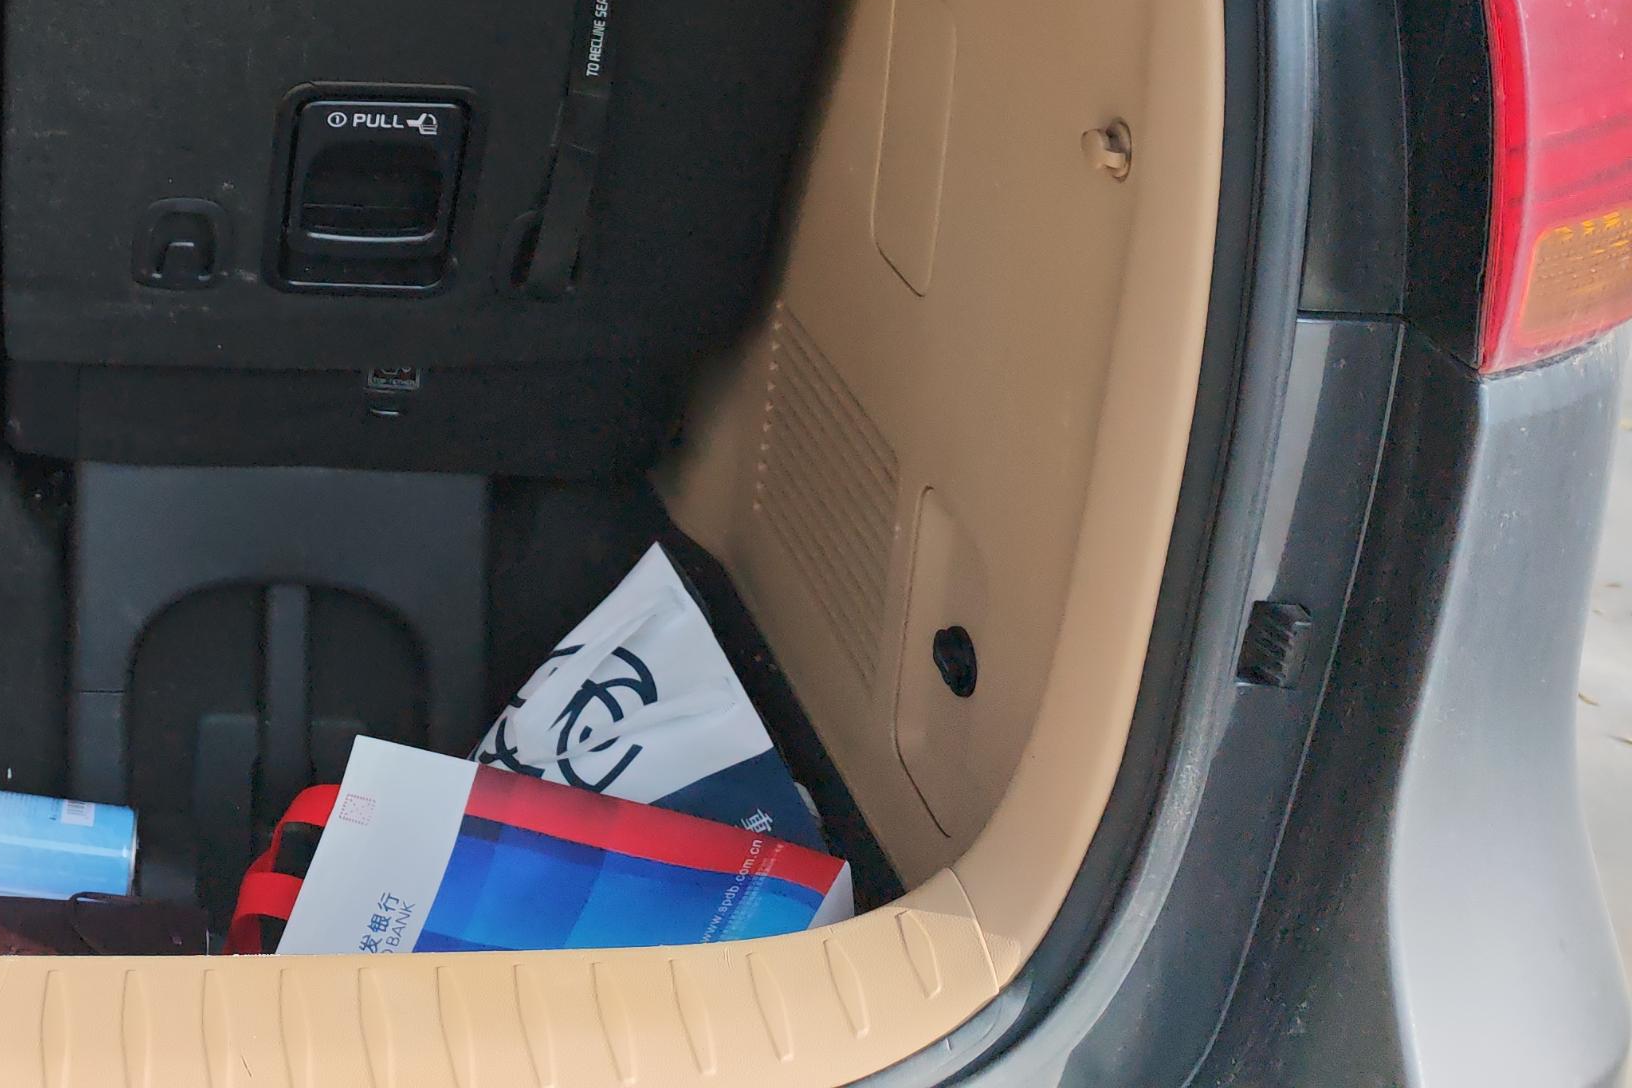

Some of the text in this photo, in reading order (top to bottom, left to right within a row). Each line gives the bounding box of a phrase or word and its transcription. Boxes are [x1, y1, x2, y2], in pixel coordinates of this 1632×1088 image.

[588, 19, 607, 63] RECLINE
[585, 62, 600, 78] TO
[352, 113, 405, 129] PULL
[358, 892, 400, 953] 发银行
[385, 900, 416, 947] BANK
